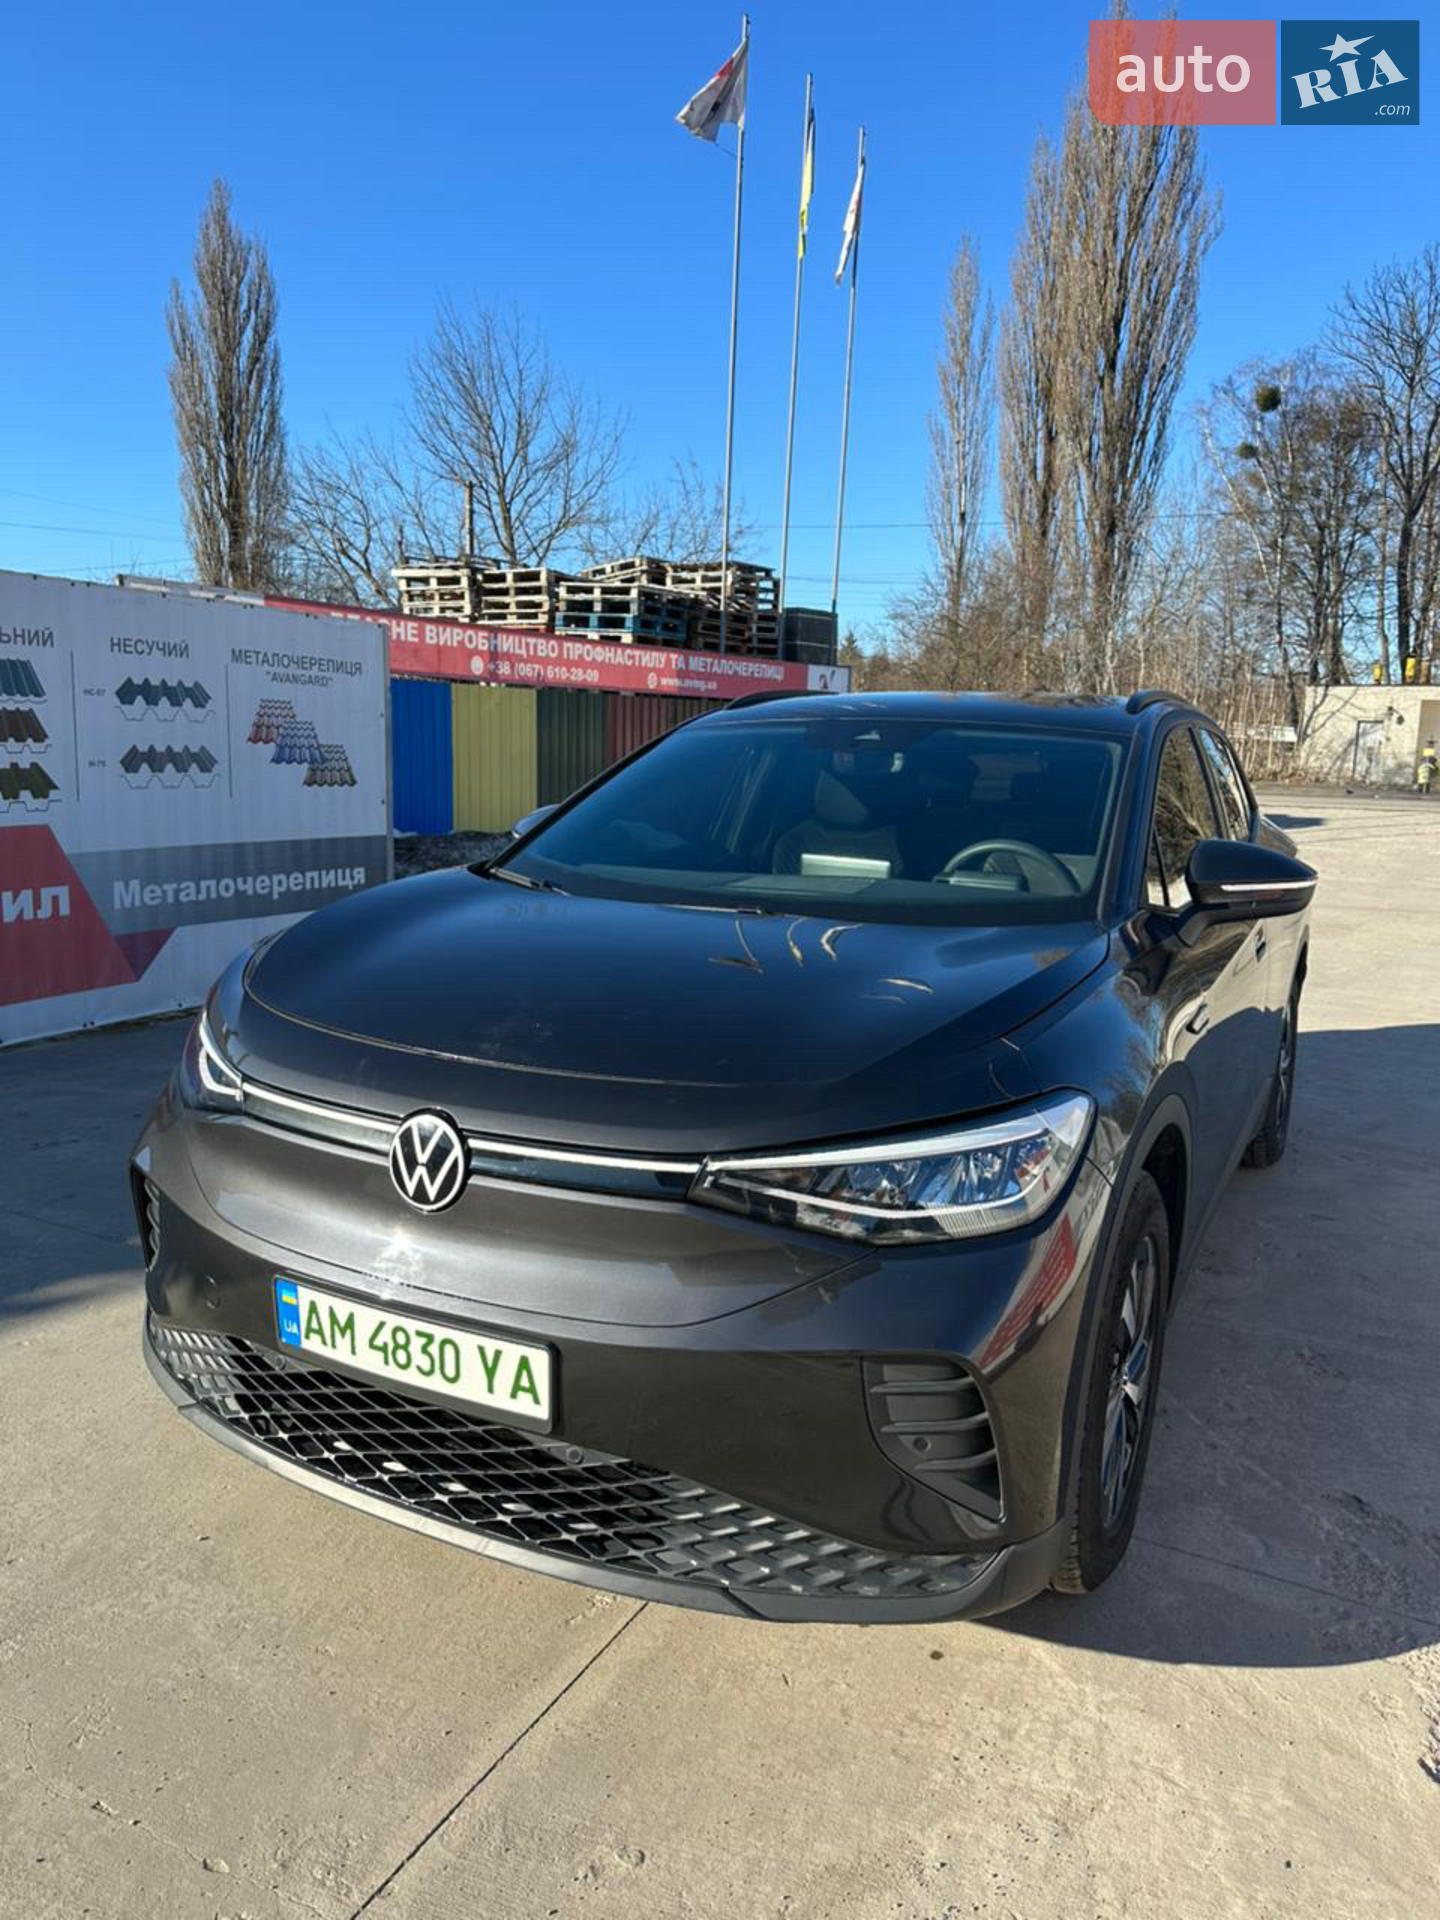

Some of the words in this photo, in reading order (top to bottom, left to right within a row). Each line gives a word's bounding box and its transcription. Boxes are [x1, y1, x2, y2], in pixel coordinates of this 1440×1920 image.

[110, 636, 190, 659] НЕСУЧИЙ
[231, 647, 363, 677] МЕТАЛОЧЕРЕПИЦЯ
[425, 624, 559, 658] ВИРОБНИЦТВО
[563, 642, 667, 669] ПРОФНАСТИЛУ
[669, 653, 686, 670] ТА
[514, 662, 544, 680] (067)
[113, 867, 366, 910] Металочерепиця
[303, 1299, 357, 1356] AM
[368, 1320, 461, 1385] 4830
[477, 1344, 541, 1406] YA
